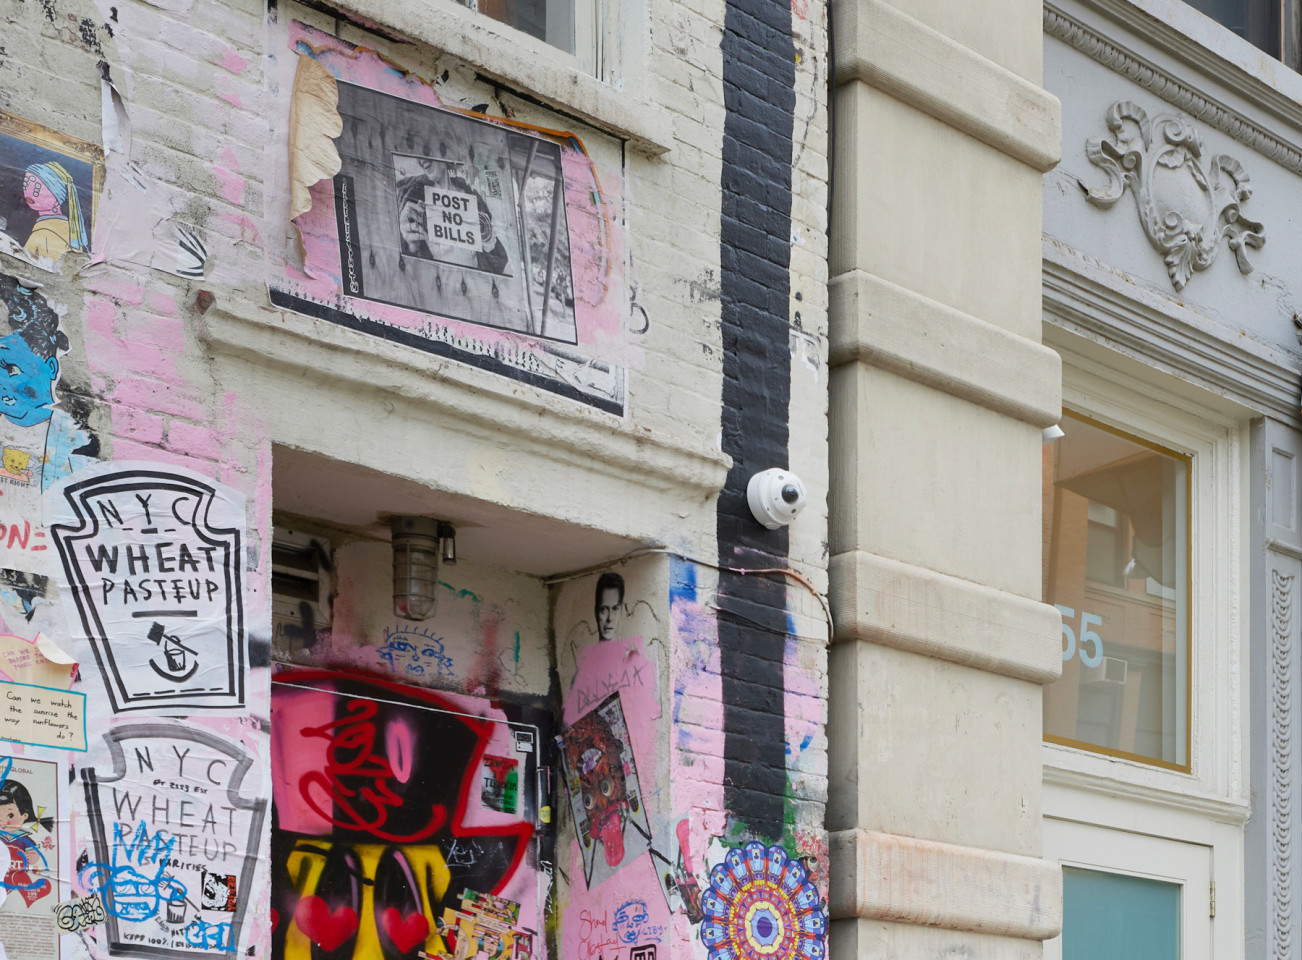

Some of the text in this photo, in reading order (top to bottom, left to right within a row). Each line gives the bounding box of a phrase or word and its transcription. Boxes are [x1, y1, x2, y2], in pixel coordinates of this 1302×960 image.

[432, 192, 470, 211] POST
[442, 211, 463, 226] NO
[433, 224, 475, 245] BILLS
[96, 494, 190, 527] NYC
[85, 542, 217, 575] WHEAT
[101, 578, 219, 605] PASTEUP
[6, 691, 22, 701] Can
[51, 699, 72, 708] watch
[5, 717, 69, 729] way sunflowers
[9, 705, 78, 720] the sunrise the
[135, 745, 227, 786] NYC
[113, 787, 238, 836] WHEAT
